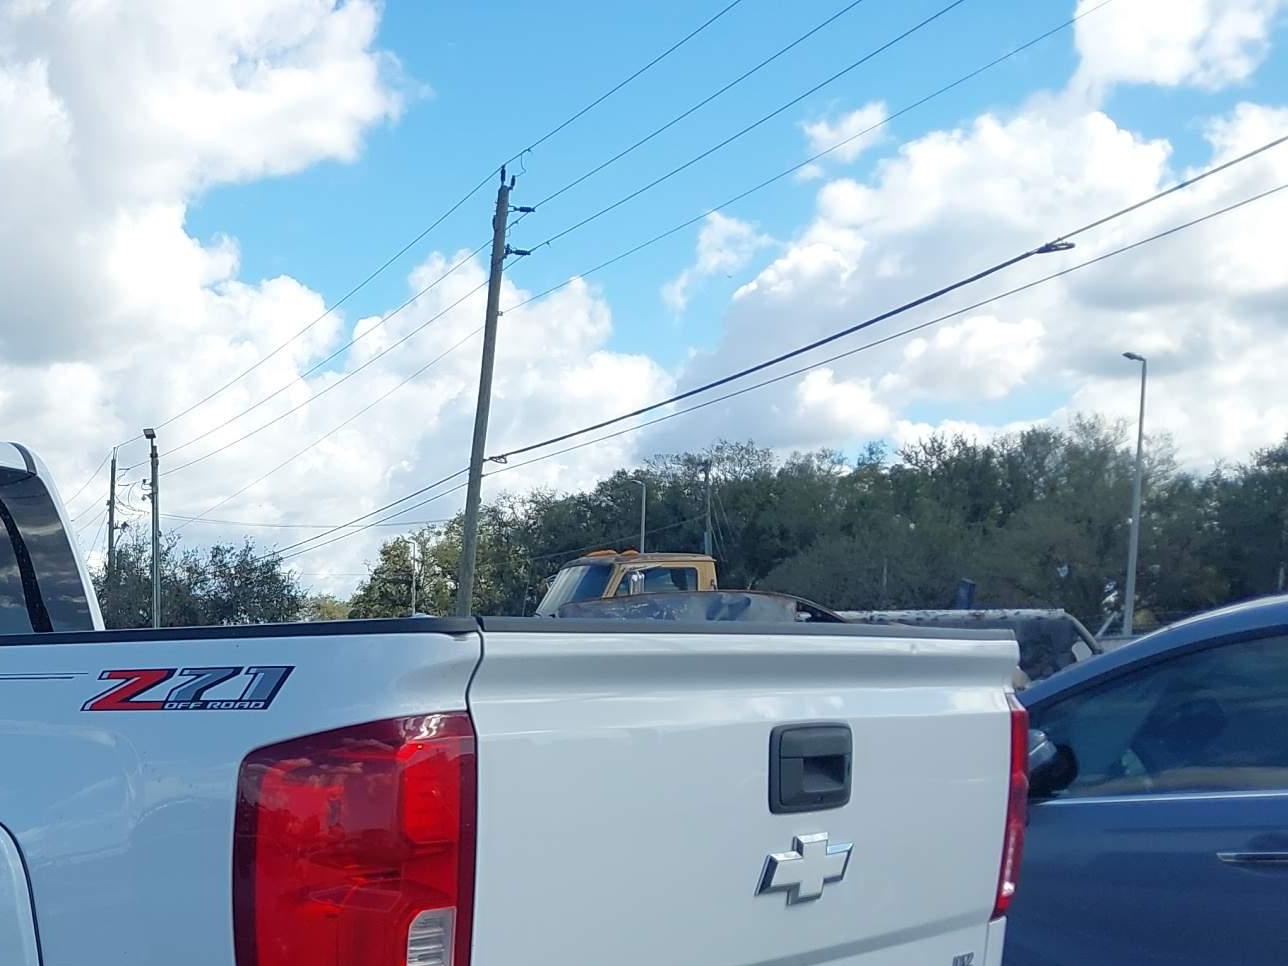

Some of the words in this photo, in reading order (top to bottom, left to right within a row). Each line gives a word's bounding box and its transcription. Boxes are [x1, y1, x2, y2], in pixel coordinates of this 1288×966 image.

[79, 665, 296, 712] Z71
[164, 701, 203, 710] OFF
[207, 701, 264, 710] ROAD
